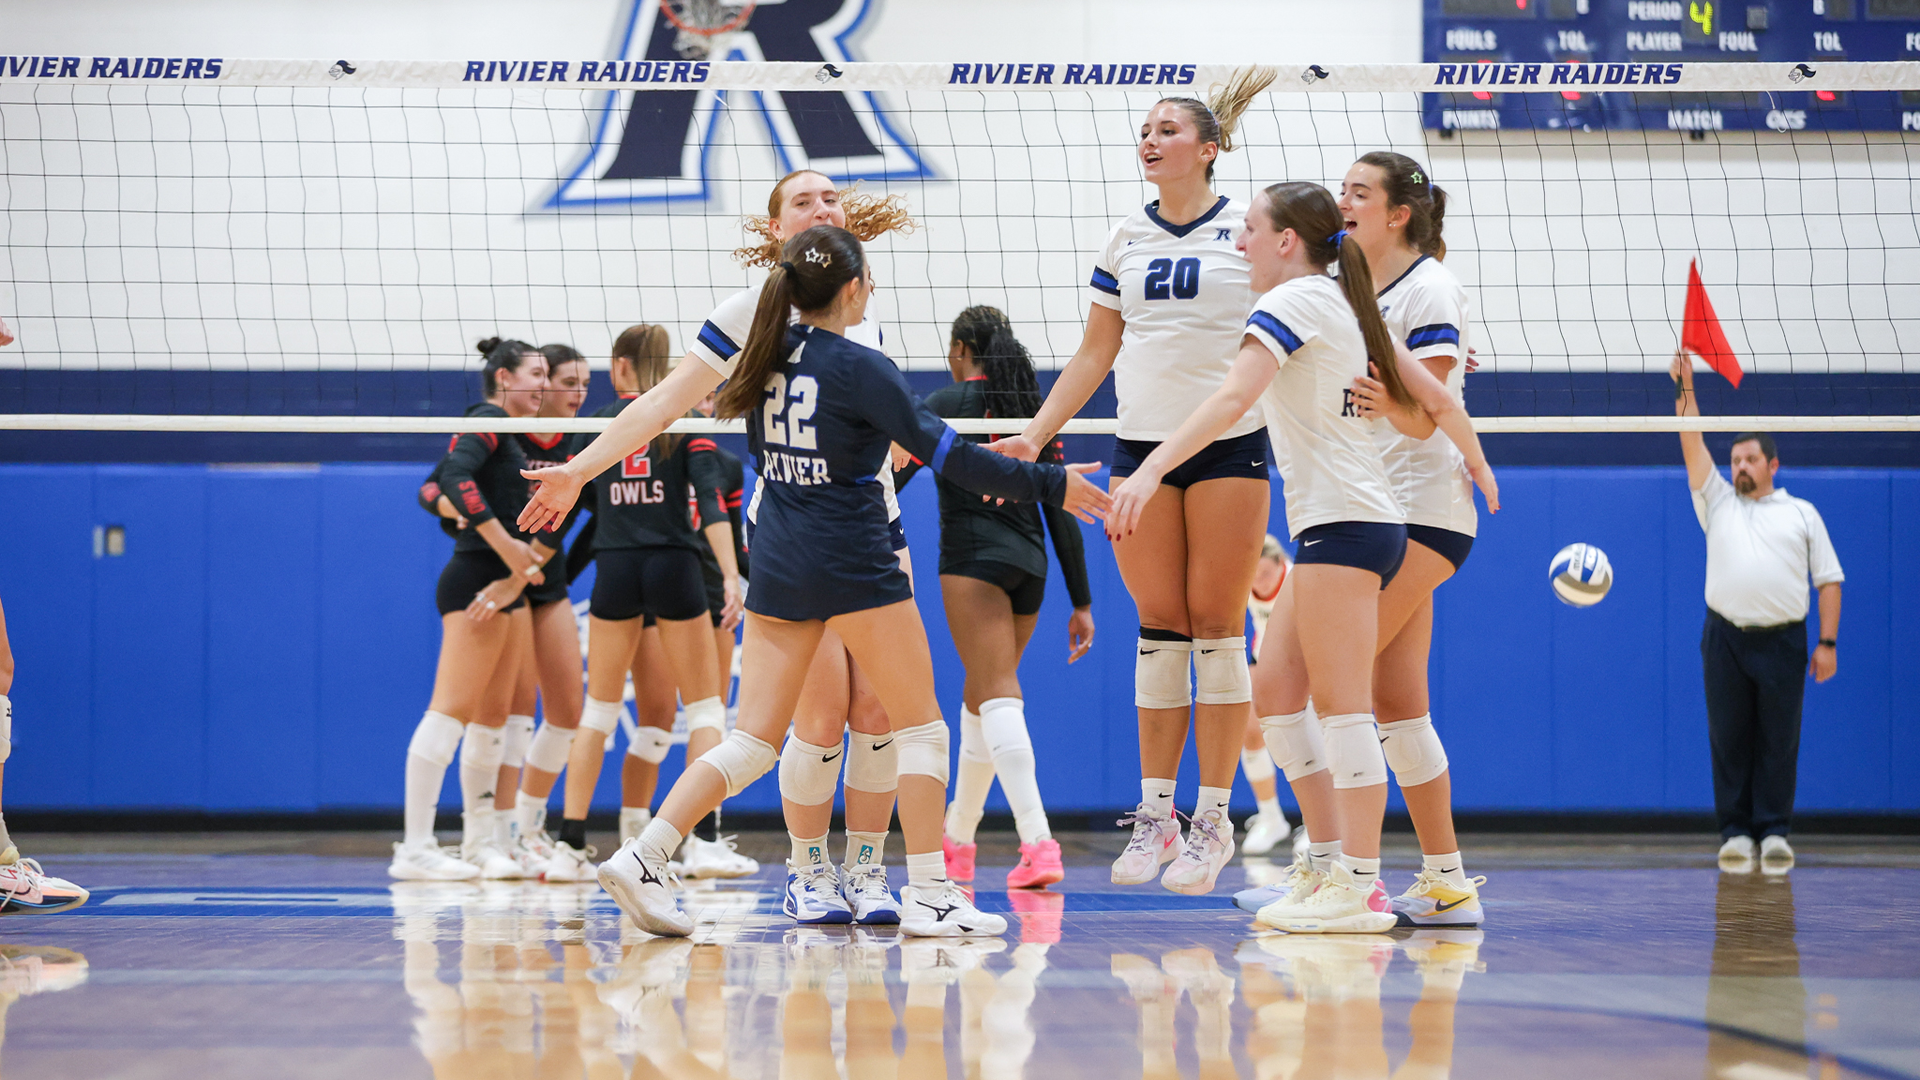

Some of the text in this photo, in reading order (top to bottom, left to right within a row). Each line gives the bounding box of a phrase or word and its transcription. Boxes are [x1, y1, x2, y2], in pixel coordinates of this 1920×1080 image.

[1628, 1, 1713, 35] PERIOD 4
[1446, 29, 1497, 51] FOULS
[1558, 30, 1588, 51] TOL
[1626, 31, 1758, 51] PLAYER FOUL
[1813, 32, 1843, 51] TOL
[0, 56, 223, 79] IVIER RAIDERS
[462, 60, 711, 83] RIVIER RAIDERS
[948, 63, 1197, 86] RIVIER RAIDERS
[1434, 64, 1684, 85] RIVIER RAIDERS
[1442, 109, 1500, 130] POINTS
[1667, 109, 1723, 130] MATCH
[1213, 228, 1231, 242] R
[1145, 257, 1201, 301] 20
[763, 371, 819, 451] 22
[621, 439, 652, 479] 2
[762, 449, 832, 486] RIVIER
[610, 479, 665, 506] OWLS
